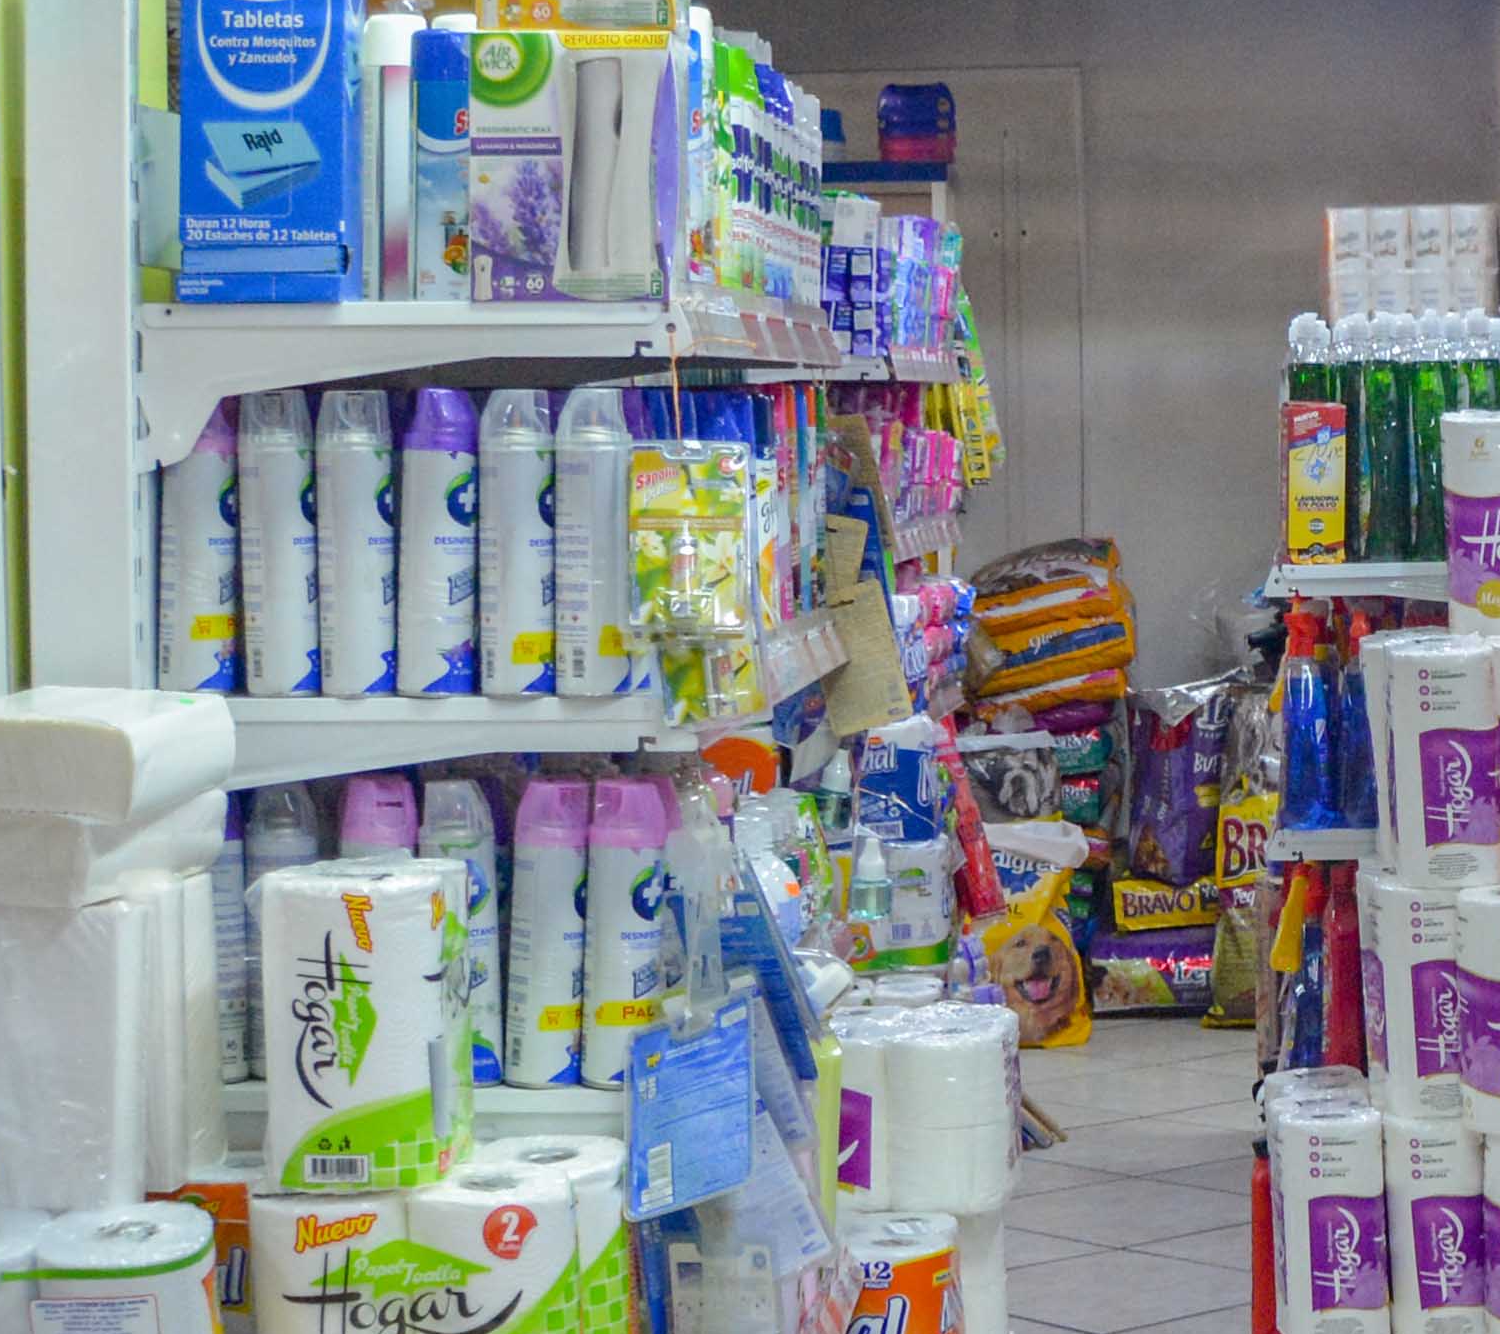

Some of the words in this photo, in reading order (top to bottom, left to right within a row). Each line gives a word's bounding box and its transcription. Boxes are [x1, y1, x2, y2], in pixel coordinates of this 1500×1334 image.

[222, 10, 304, 29] Tabletas
[532, 5, 550, 18] 60
[210, 35, 249, 49] Contra
[253, 35, 317, 51] Mosquitos
[563, 34, 619, 46] REPUESTO
[622, 34, 665, 46] GRATIS
[227, 53, 236, 67] y
[238, 50, 297, 65] Zancudos
[484, 44, 512, 56] AIR
[478, 54, 517, 71] WICK
[242, 128, 284, 155] Raid
[186, 217, 219, 231] Duran
[222, 217, 236, 229] 12
[239, 217, 271, 229] Horas
[187, 229, 203, 241] 20
[205, 229, 254, 242] Estuches
[256, 229, 270, 241] de
[272, 229, 288, 241] 12
[290, 229, 337, 242] Tabletas
[525, 276, 544, 290] 60
[1426, 740, 1474, 838] Hogar
[1121, 885, 1196, 918] BRAVO
[341, 893, 373, 953] Nuevo
[292, 929, 372, 1110] Hogar
[295, 1213, 379, 1253] Nuevo
[501, 1212, 522, 1242] 2
[1313, 1206, 1361, 1304] Hogar
[1419, 1207, 1465, 1303] Hogar
